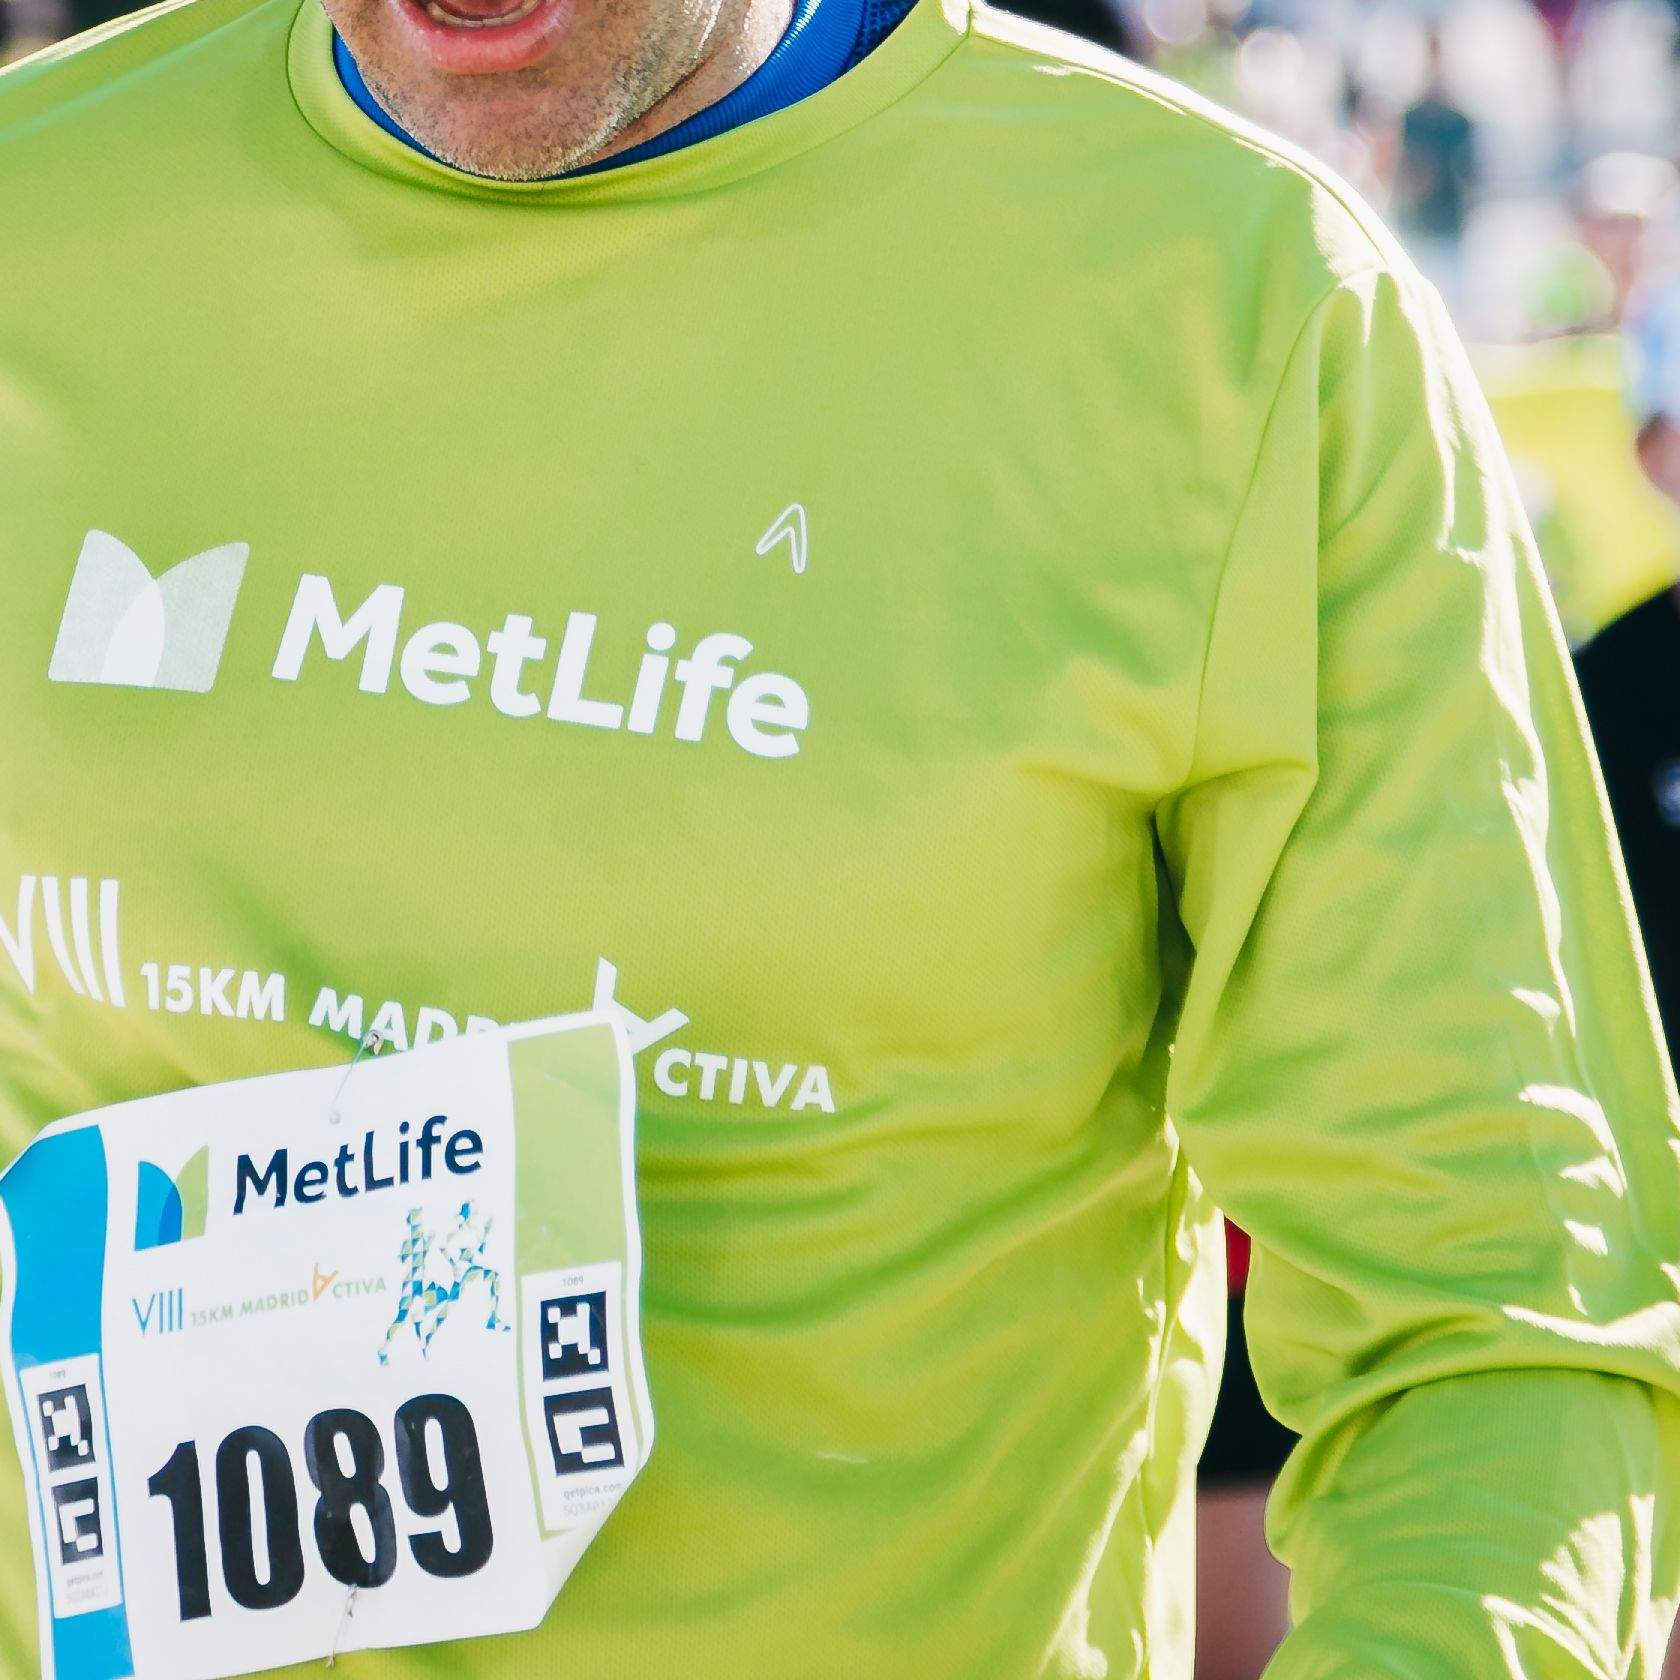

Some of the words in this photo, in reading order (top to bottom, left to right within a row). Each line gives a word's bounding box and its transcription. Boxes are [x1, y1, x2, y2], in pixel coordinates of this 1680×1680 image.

[271, 572, 811, 759] MetLife
[140, 961, 286, 1023] 15KM
[232, 1114, 484, 1217] MetLife
[131, 1287, 184, 1337] VIII
[191, 1303, 234, 1328] 15KM
[239, 1288, 310, 1319] MADRID
[146, 1392, 495, 1624] 1089
